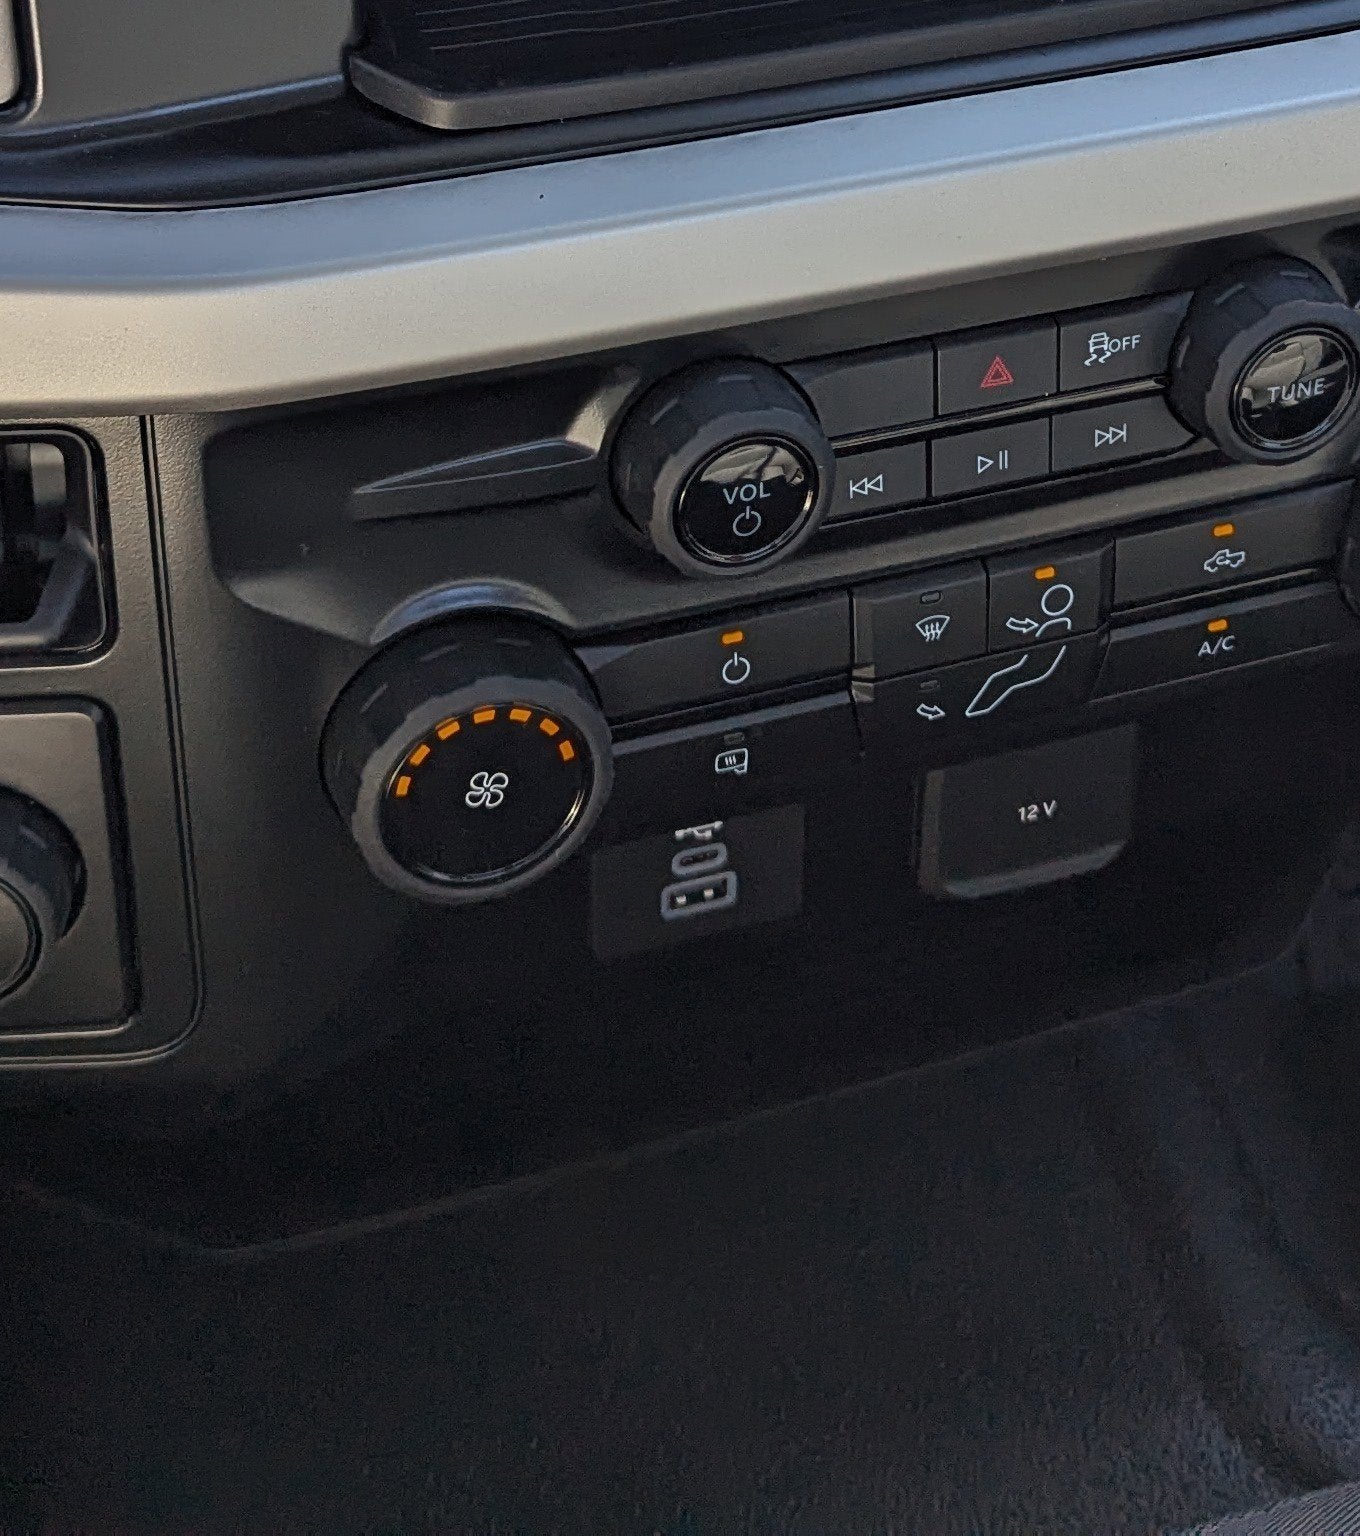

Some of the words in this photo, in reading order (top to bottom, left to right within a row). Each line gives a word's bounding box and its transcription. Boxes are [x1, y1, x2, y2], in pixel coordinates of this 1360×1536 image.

[1107, 334, 1141, 353] OFF
[1267, 377, 1325, 403] TUNE
[722, 481, 771, 505] VOL
[1197, 634, 1237, 657] A/C
[1018, 804, 1039, 822] 12
[1043, 799, 1057, 817] V
